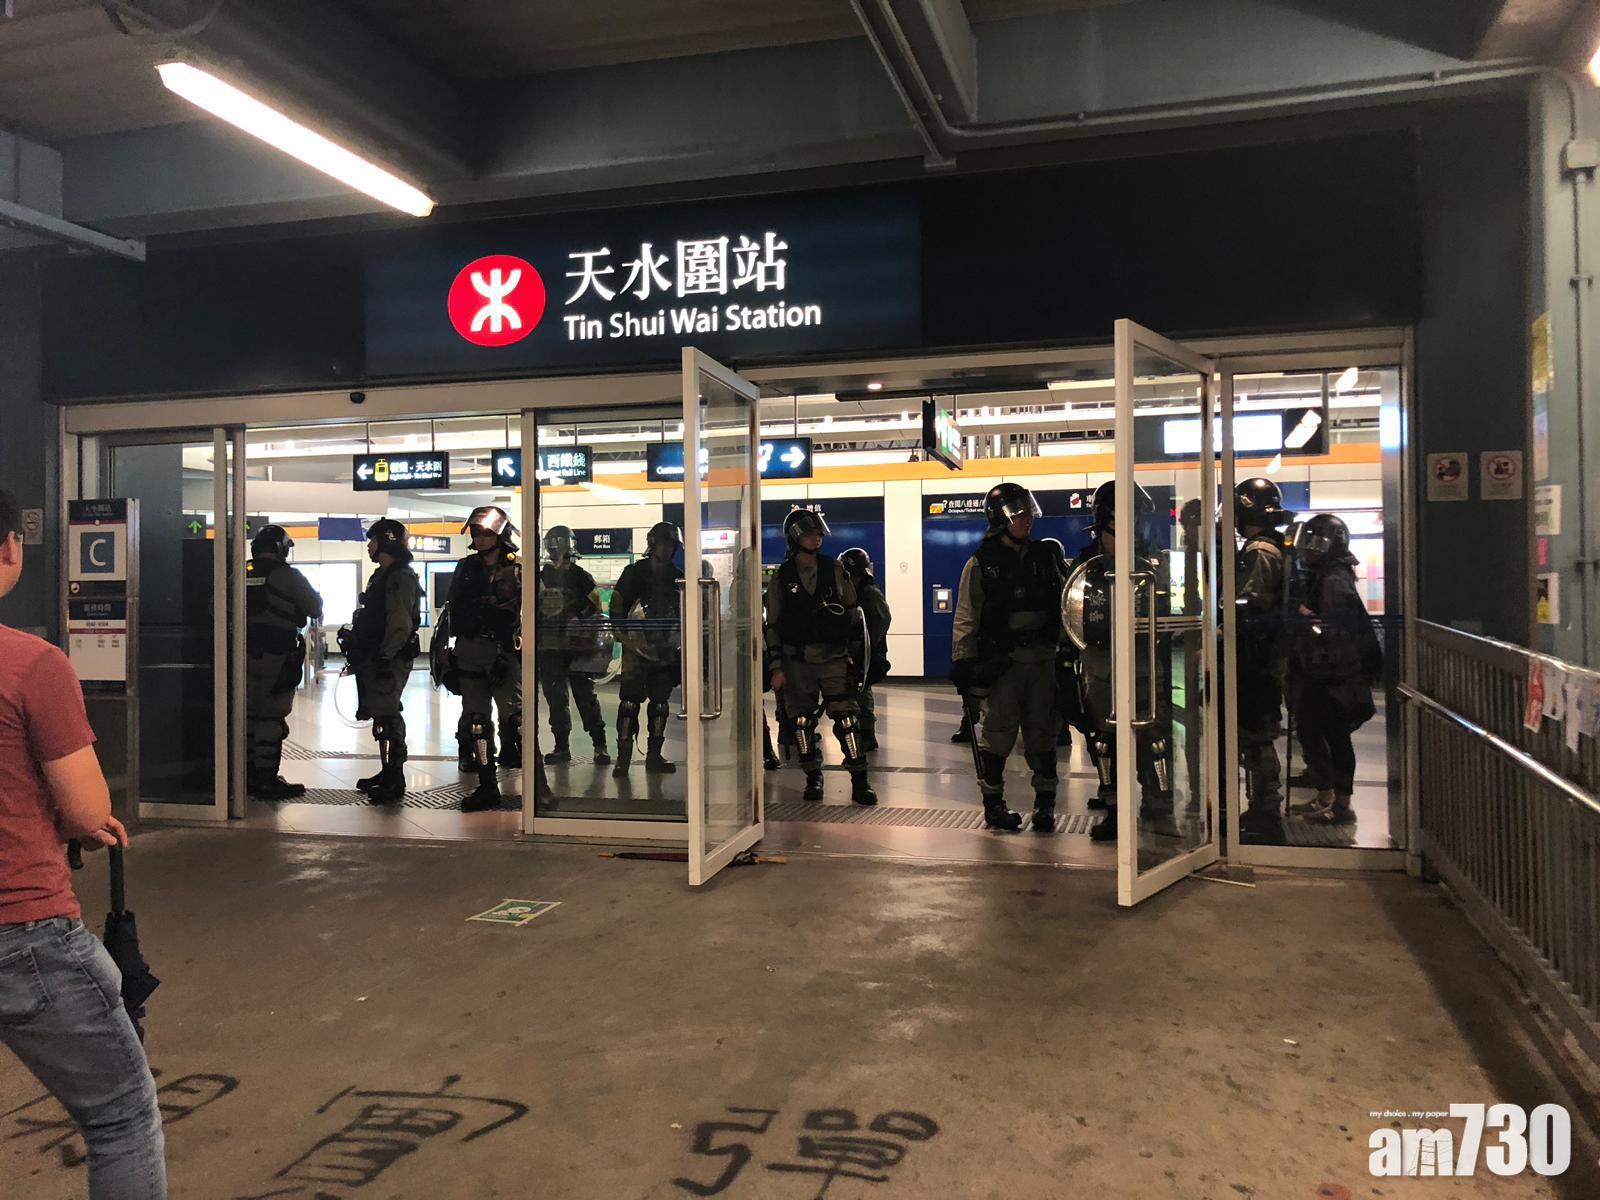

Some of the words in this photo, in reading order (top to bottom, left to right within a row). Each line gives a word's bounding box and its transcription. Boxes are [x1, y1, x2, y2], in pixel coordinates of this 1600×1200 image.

[564, 231, 788, 305] 天水圍站
[563, 314, 602, 341] Tin
[609, 309, 665, 338] Shui
[670, 305, 719, 334] Wai
[725, 300, 822, 332] Station
[89, 538, 106, 567] C
